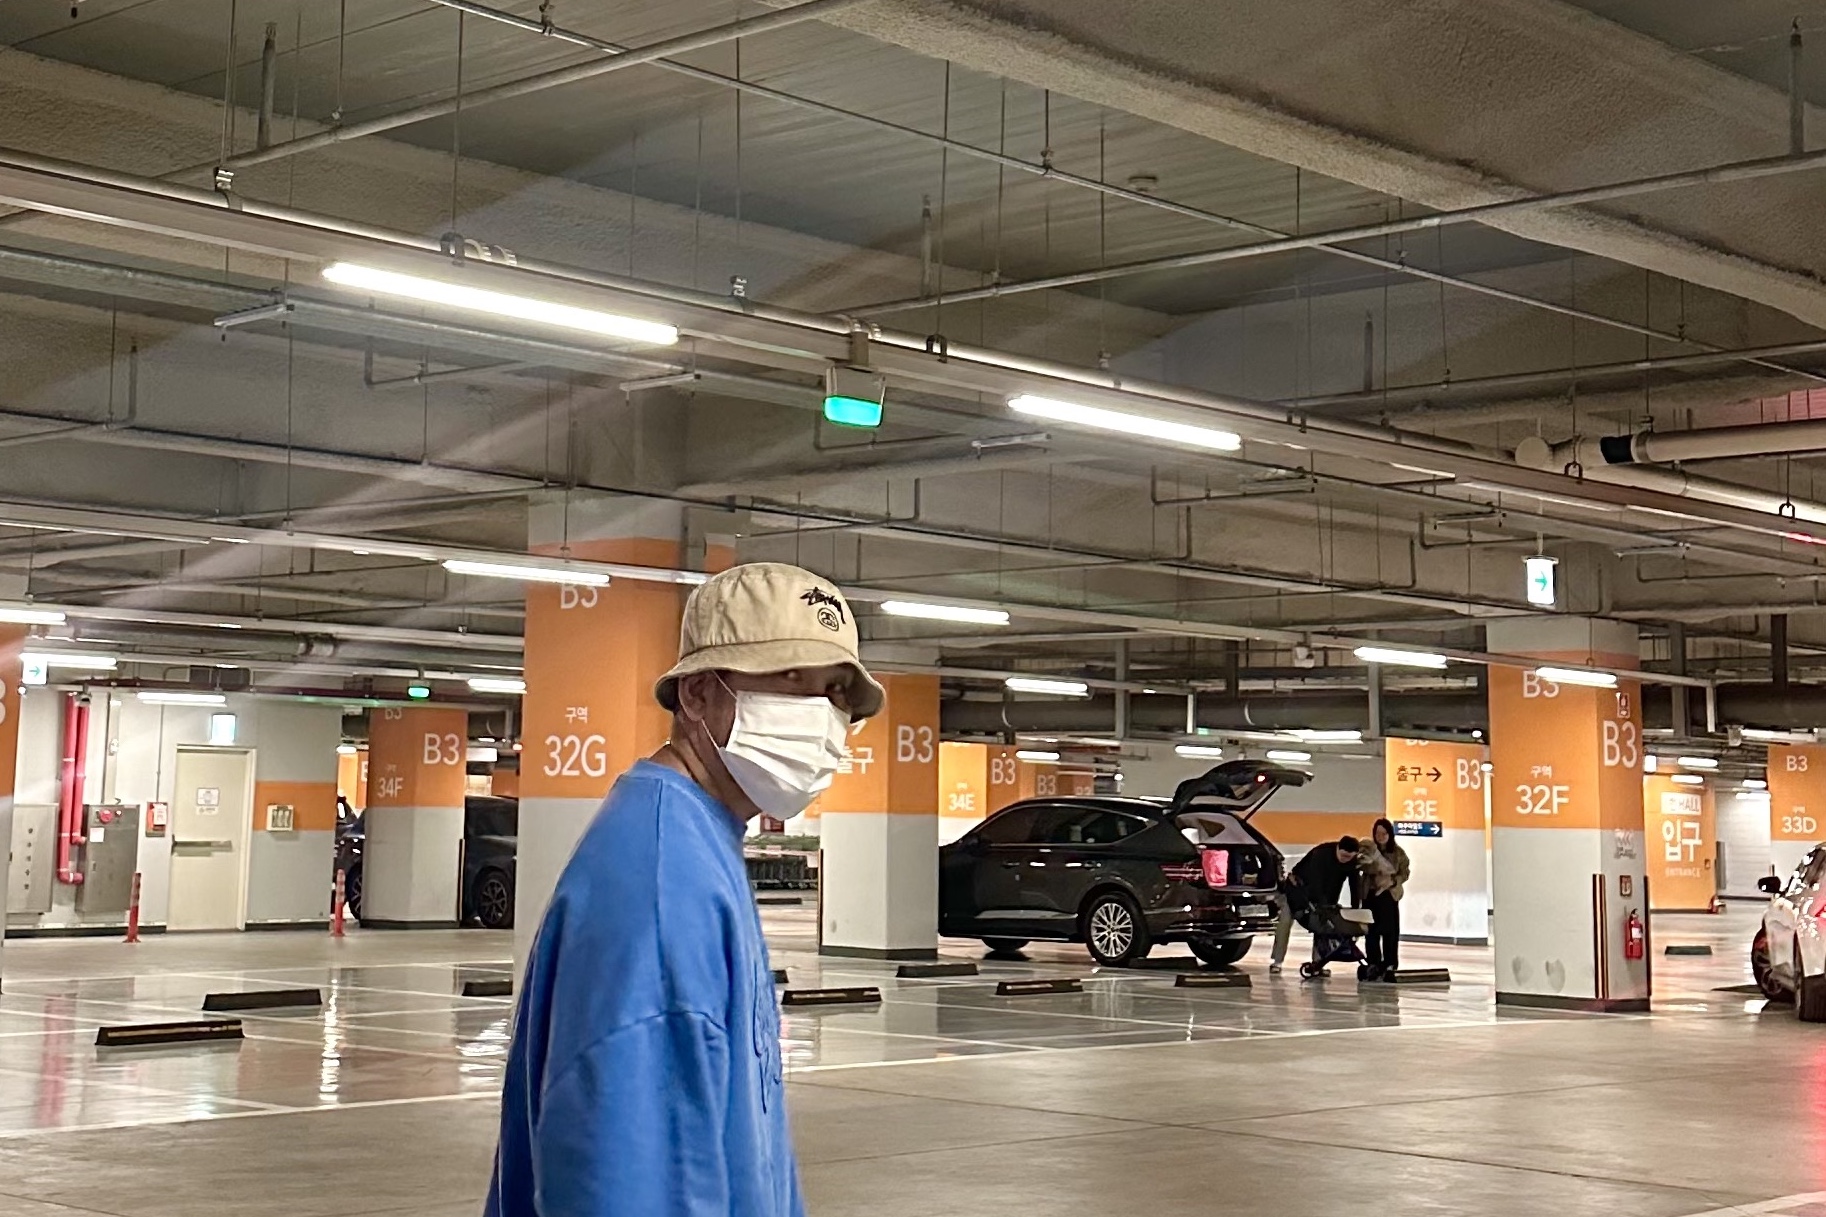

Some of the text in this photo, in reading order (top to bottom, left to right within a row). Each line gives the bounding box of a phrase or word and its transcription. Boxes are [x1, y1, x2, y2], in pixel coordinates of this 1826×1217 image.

[1523, 671, 1559, 698] B3
[565, 706, 588, 724] 구역
[423, 733, 460, 765] B3
[543, 735, 606, 777] 32G
[898, 725, 933, 763] B3
[1603, 720, 1637, 768] B3
[991, 758, 1016, 785] B3
[1397, 765, 1422, 782] 출구
[1456, 758, 1481, 789] B3
[1531, 765, 1552, 779] 구역
[1786, 755, 1808, 772] B3
[378, 778, 403, 798] 34F
[1037, 775, 1056, 795] B3
[1403, 800, 1438, 820] 33E
[1516, 785, 1569, 814] 32F
[1782, 816, 1817, 833] 33D
[1662, 819, 1702, 863] 입구
